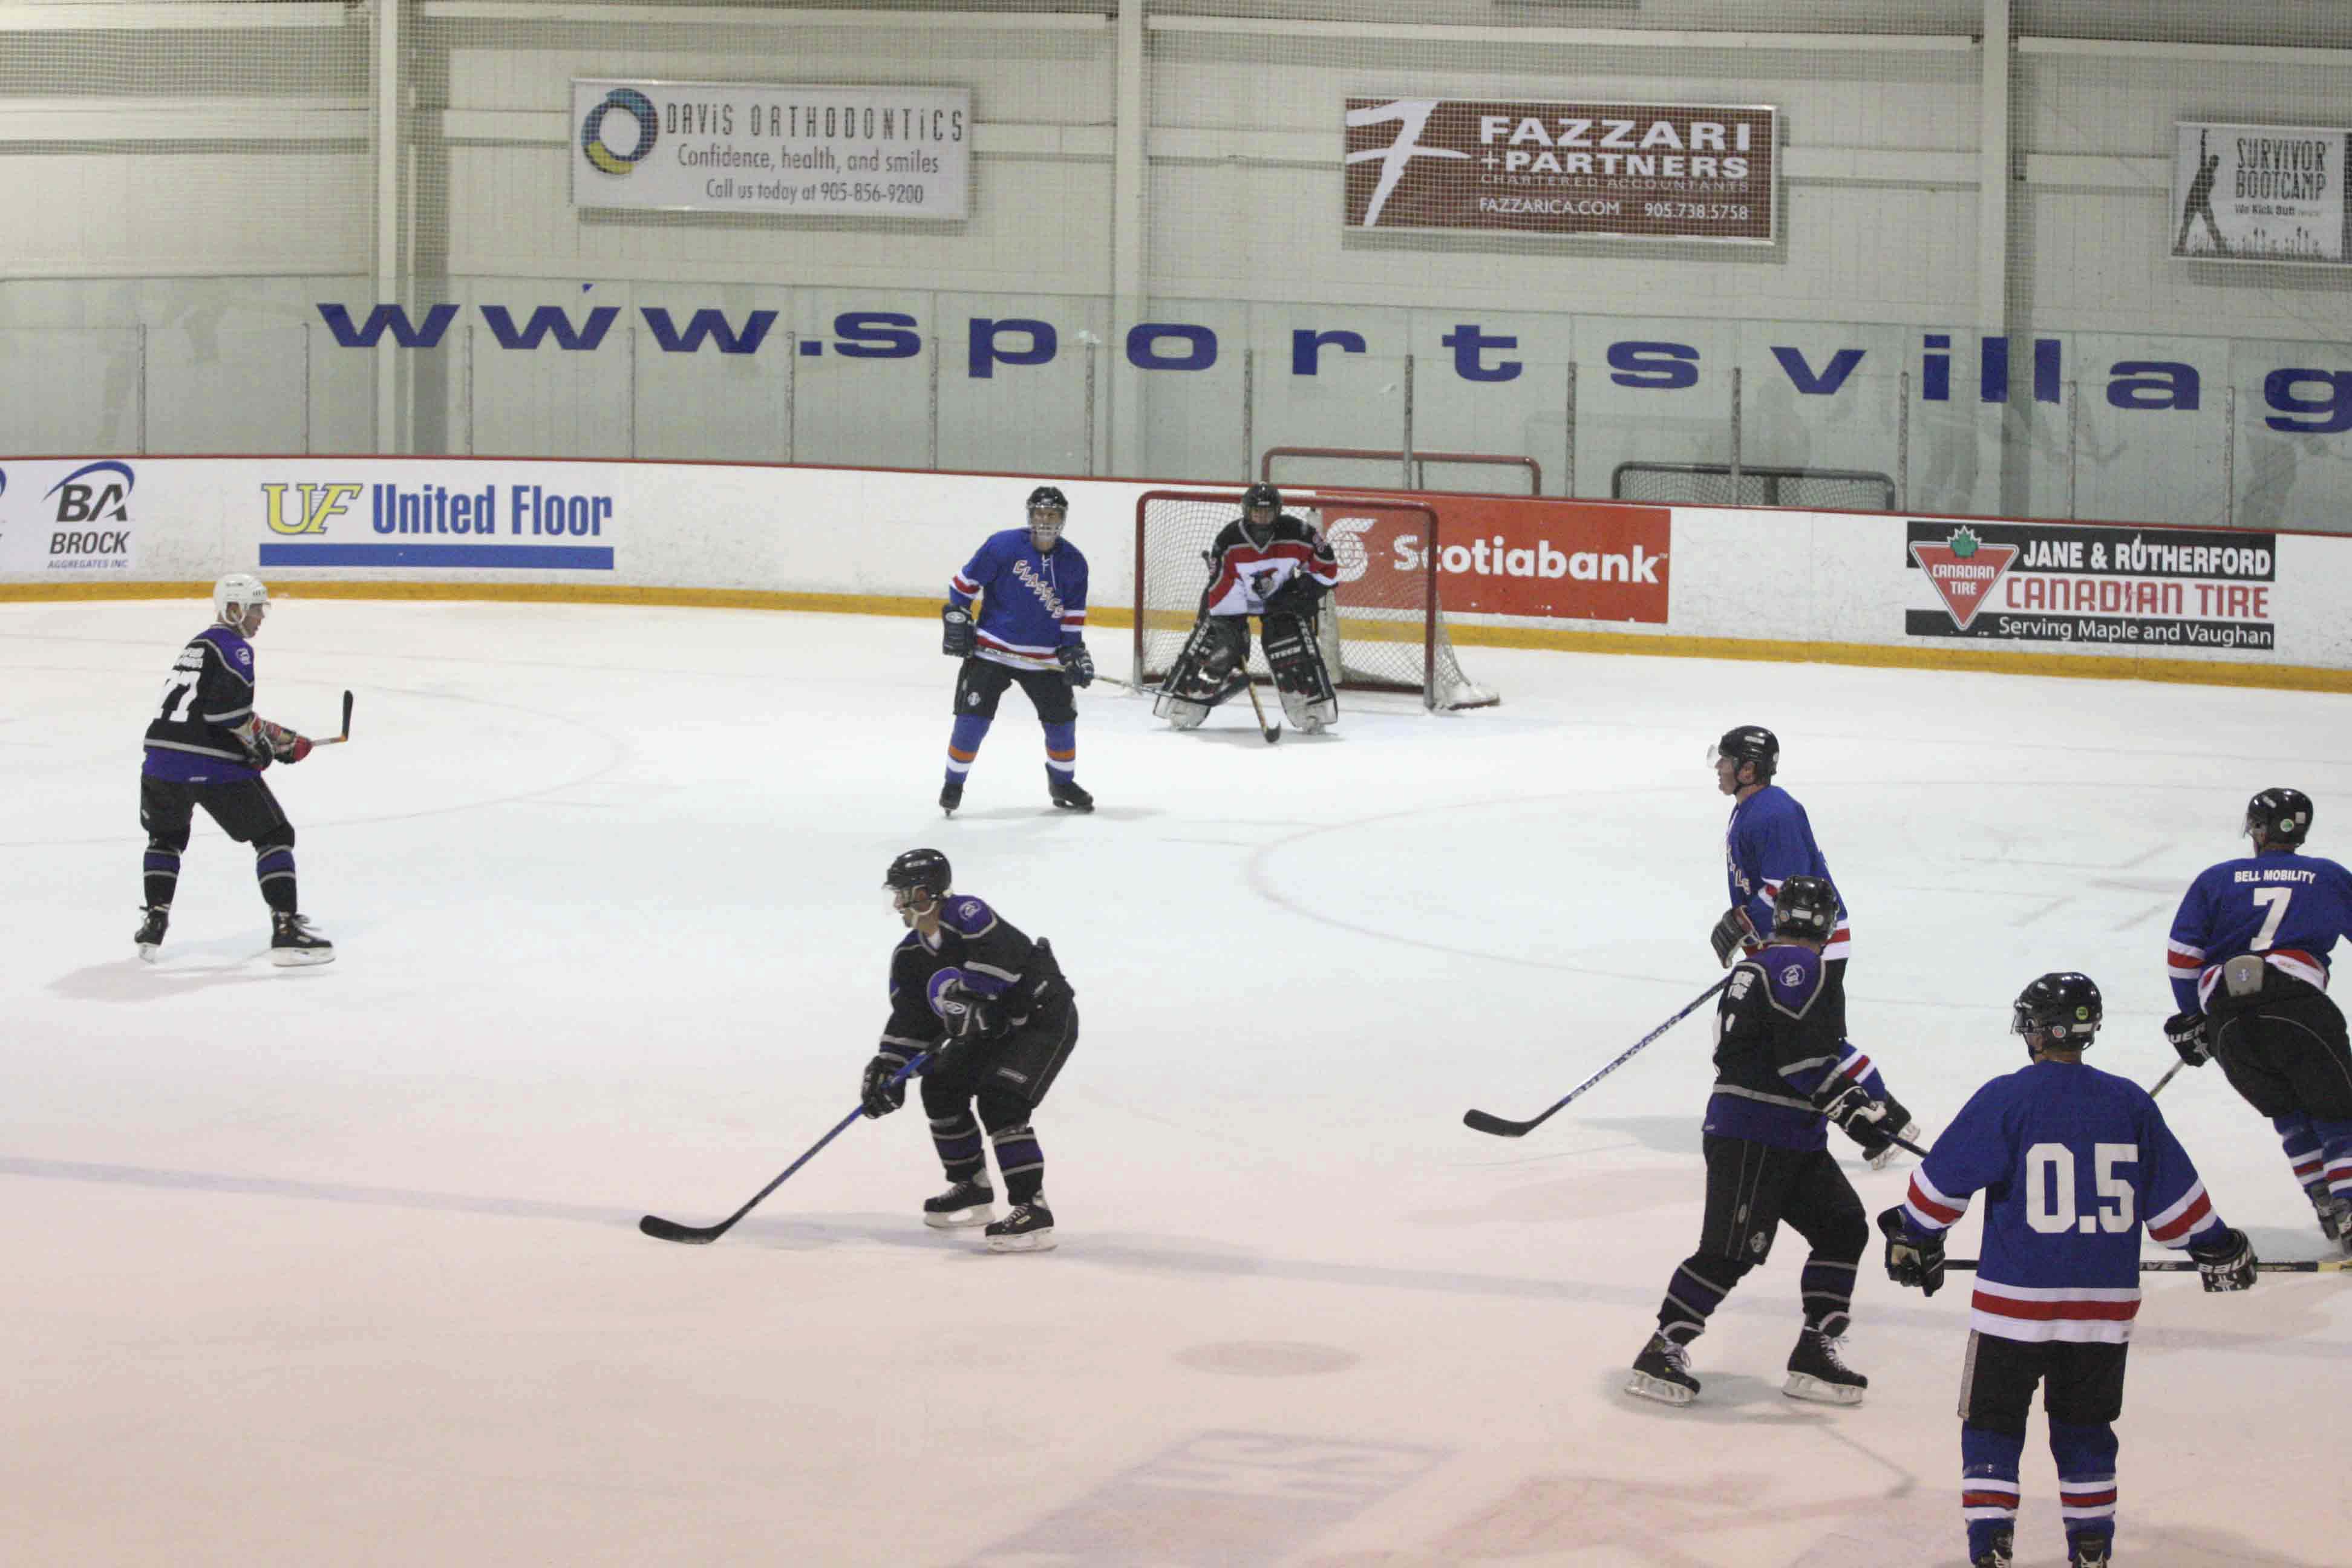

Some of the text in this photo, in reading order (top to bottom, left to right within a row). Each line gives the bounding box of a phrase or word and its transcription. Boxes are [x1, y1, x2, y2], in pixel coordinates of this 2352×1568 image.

[1480, 115, 1750, 151] FAZZARI
[678, 143, 939, 174] Confidence, health, and smiles
[707, 178, 924, 204] Call us today at 905-856-9200
[2236, 170, 2327, 200] BOOTCAMP
[1480, 198, 1619, 215] FAZZARICA.COM
[1645, 203, 1748, 220] 905.738.5758
[56, 484, 128, 521] BA
[261, 483, 363, 535] UF
[373, 484, 612, 536] United Floor
[50, 531, 130, 554] BROCK
[1932, 564, 1994, 580] CANADIAN
[2024, 541, 2271, 576] JANE & RUTHERFORD
[1950, 581, 1977, 596] TIRE
[2006, 577, 2270, 619] CANADIAN TIRE
[1999, 616, 2272, 648] Serving Maple and Vaughan
[2235, 869, 2317, 884] BELL MOBILITY
[2250, 886, 2293, 952] 7
[2025, 1142, 2138, 1234] 0.5
